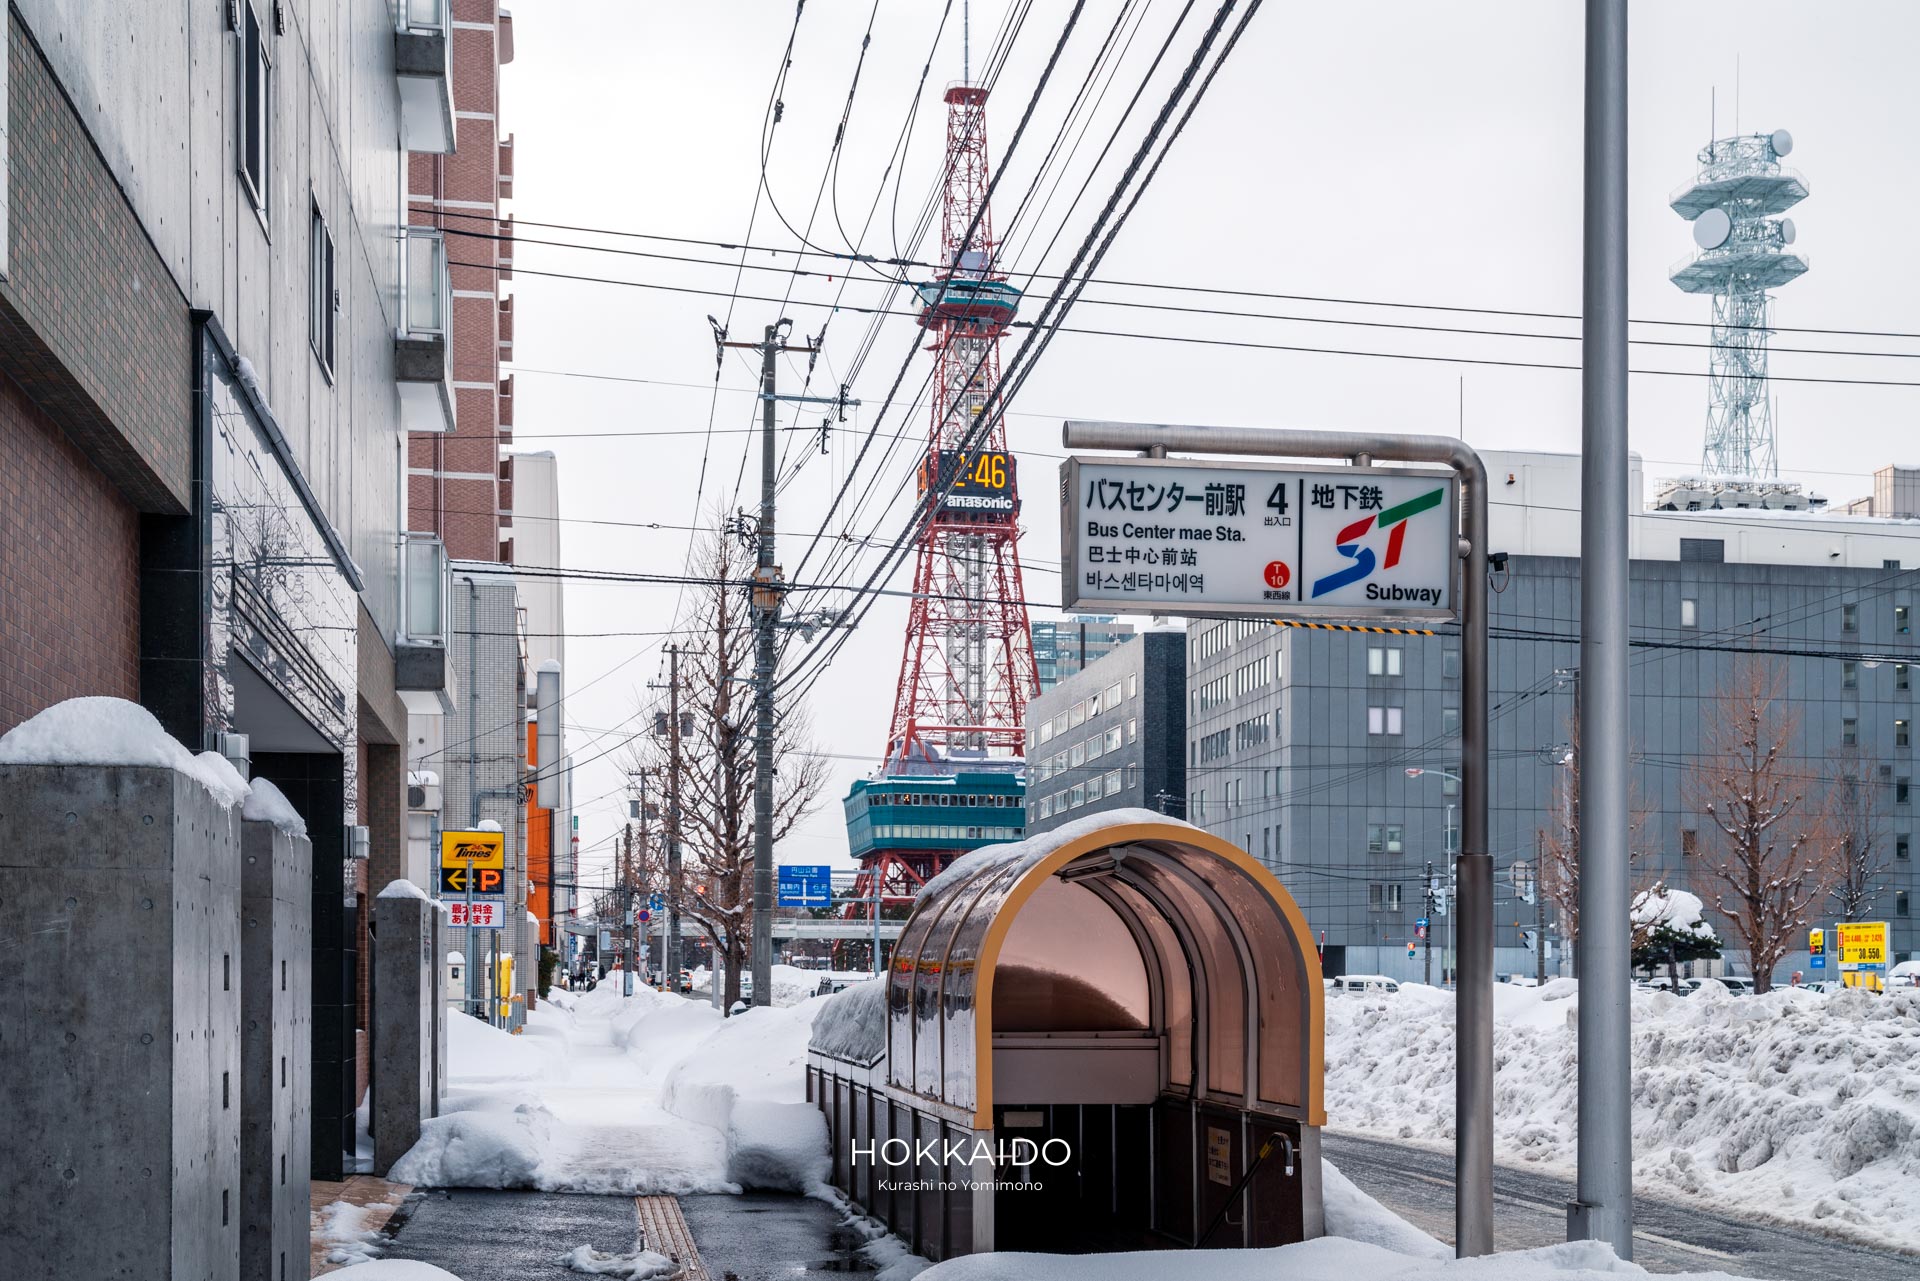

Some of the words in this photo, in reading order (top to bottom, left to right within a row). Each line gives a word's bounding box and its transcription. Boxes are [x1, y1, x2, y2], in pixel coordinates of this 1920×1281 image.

[1086, 479, 1246, 517] バスセンター前駅
[1266, 482, 1289, 515] 4
[1311, 483, 1383, 511] 地下鉄
[1088, 521, 1119, 538] Bus
[1122, 522, 1176, 540] Center
[1179, 527, 1213, 541] mae
[1216, 525, 1246, 542] Sta.
[1264, 516, 1291, 527] 出入口
[1088, 546, 1198, 567] 巴士中心前站
[1272, 563, 1281, 575] T
[1086, 570, 1204, 594] 바스센타마에역
[1270, 575, 1284, 587] 10
[1263, 590, 1291, 601] 東西線
[1365, 582, 1442, 606] Subway
[455, 844, 492, 858] Times
[481, 870, 501, 892] P
